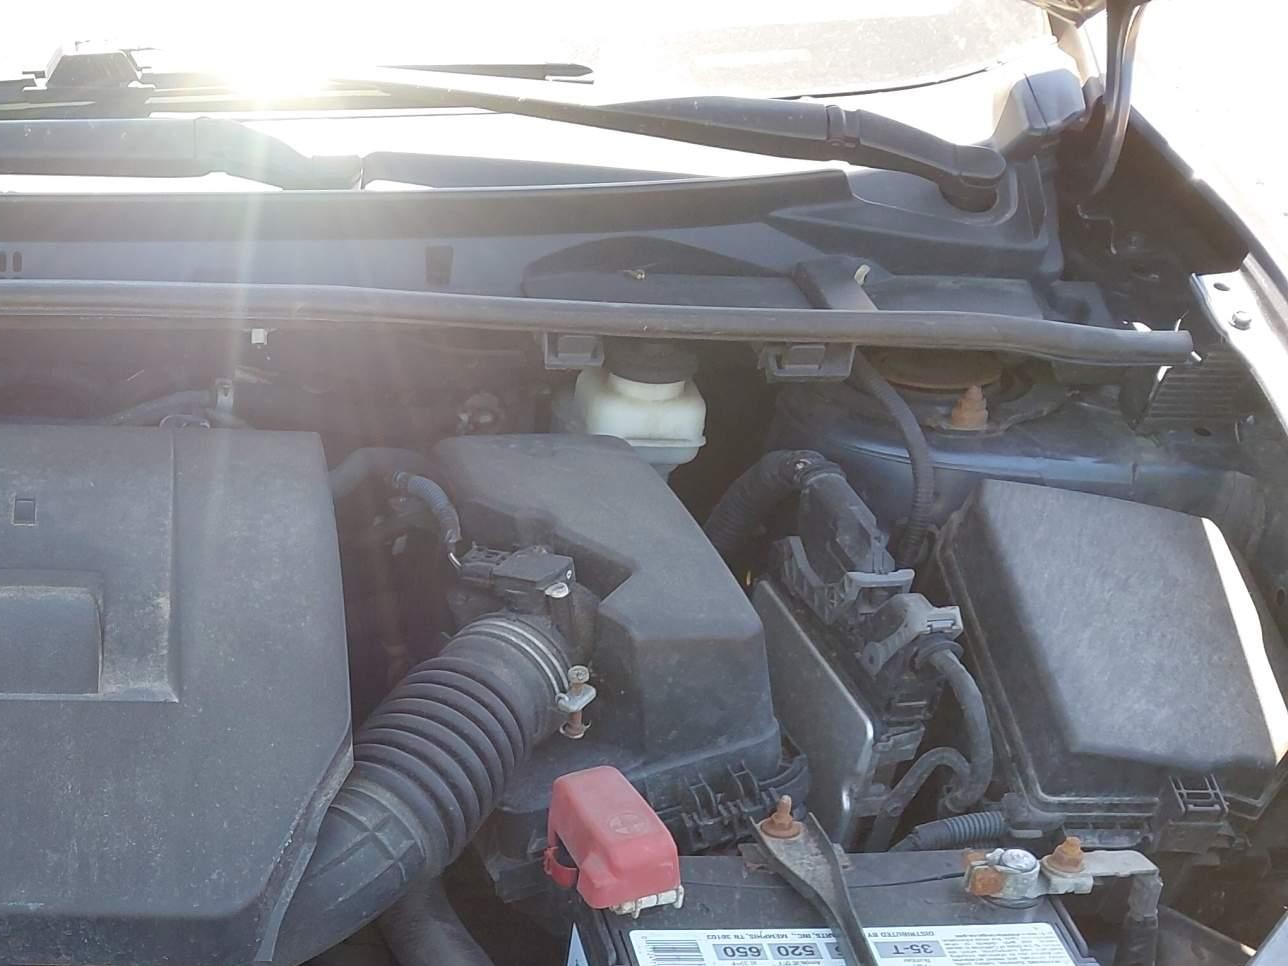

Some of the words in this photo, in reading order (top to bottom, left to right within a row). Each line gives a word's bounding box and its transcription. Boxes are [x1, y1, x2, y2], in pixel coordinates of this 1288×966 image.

[722, 946, 761, 957] 650
[776, 945, 816, 956] 520
[892, 944, 934, 954] 35-T
